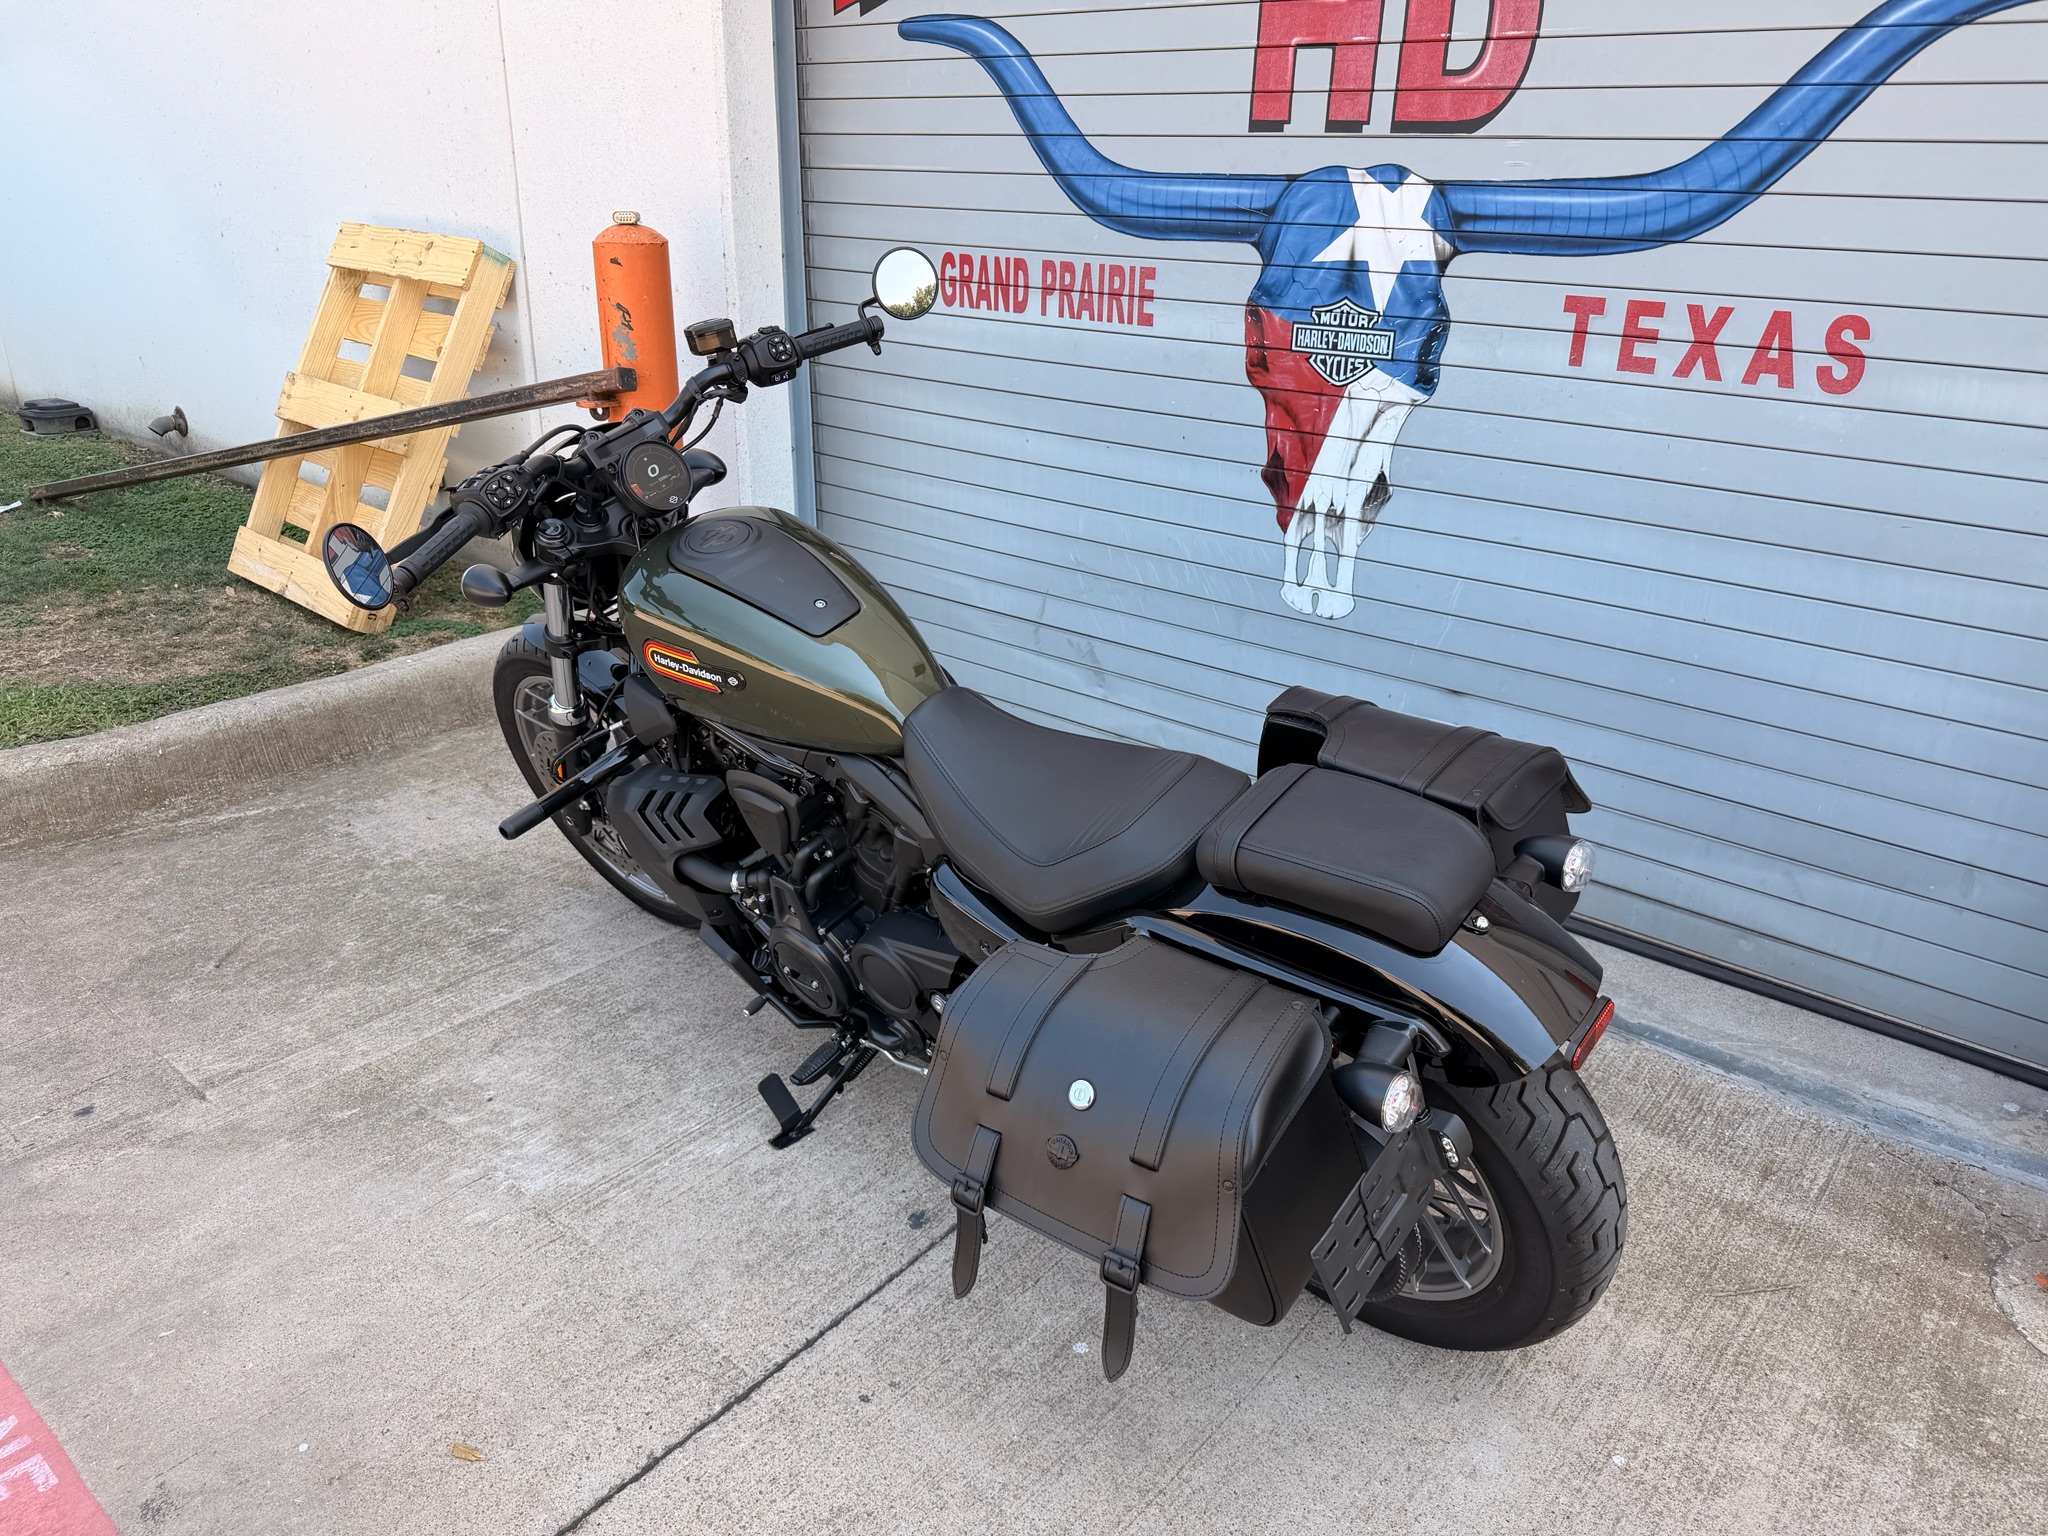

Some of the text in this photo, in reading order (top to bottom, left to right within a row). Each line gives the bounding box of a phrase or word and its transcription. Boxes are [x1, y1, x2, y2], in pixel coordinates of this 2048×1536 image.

[940, 251, 1156, 327] GRAND PRAIRIE
[1320, 306, 1369, 328] MOTOR
[1296, 328, 1389, 355] HARLEY-DAVIDSON
[1563, 295, 1871, 395] TEXAS
[1316, 355, 1365, 381] CYCLES
[653, 653, 722, 683] Harley-Davidson
